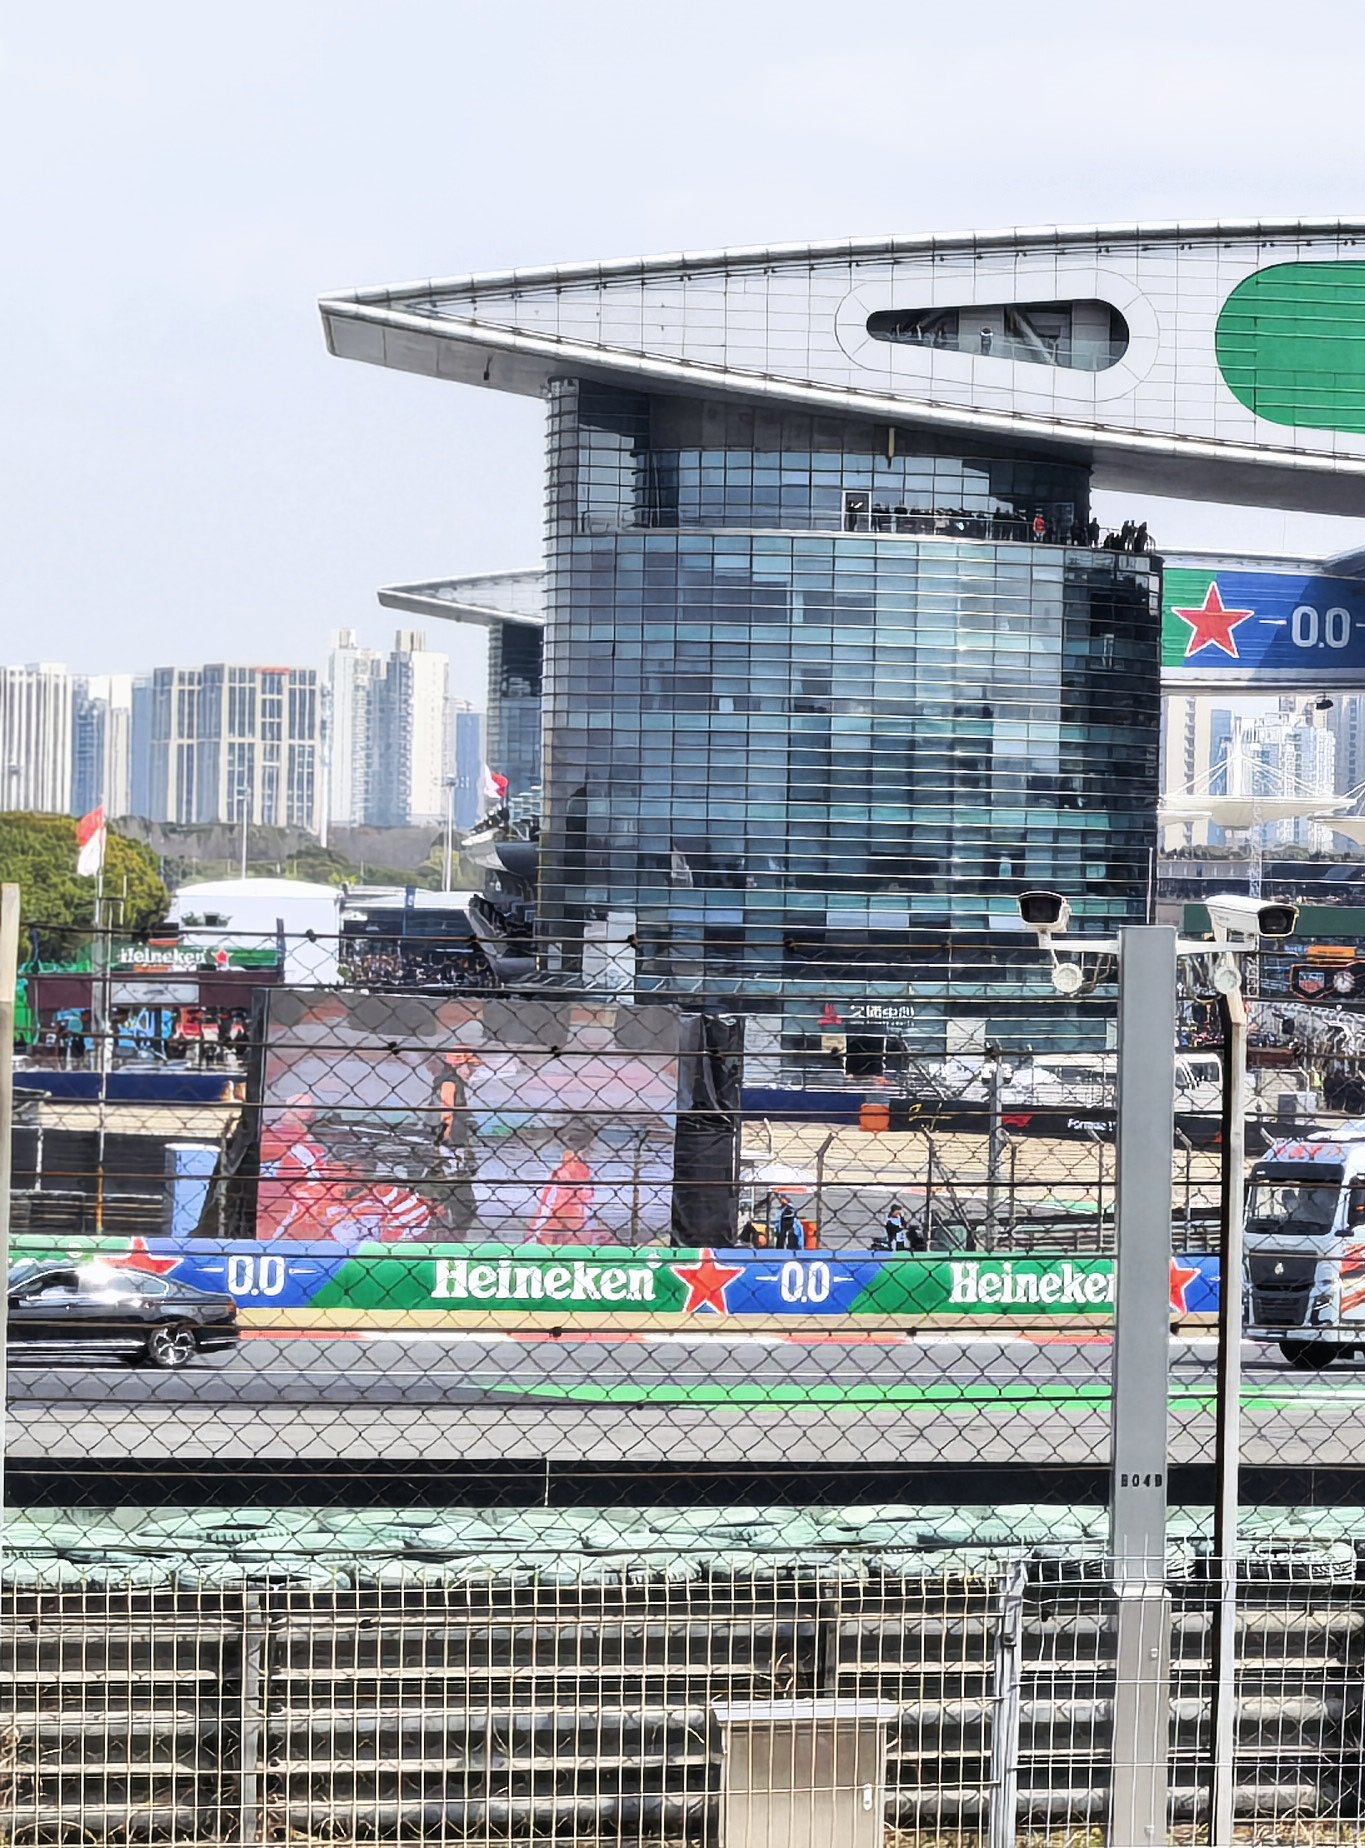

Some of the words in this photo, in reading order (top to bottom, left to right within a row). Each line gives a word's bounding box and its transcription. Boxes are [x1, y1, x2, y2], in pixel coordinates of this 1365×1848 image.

[120, 947, 207, 966] Heineken
[430, 1255, 656, 1301] Heineken
[947, 1262, 1115, 1305] Heineke
